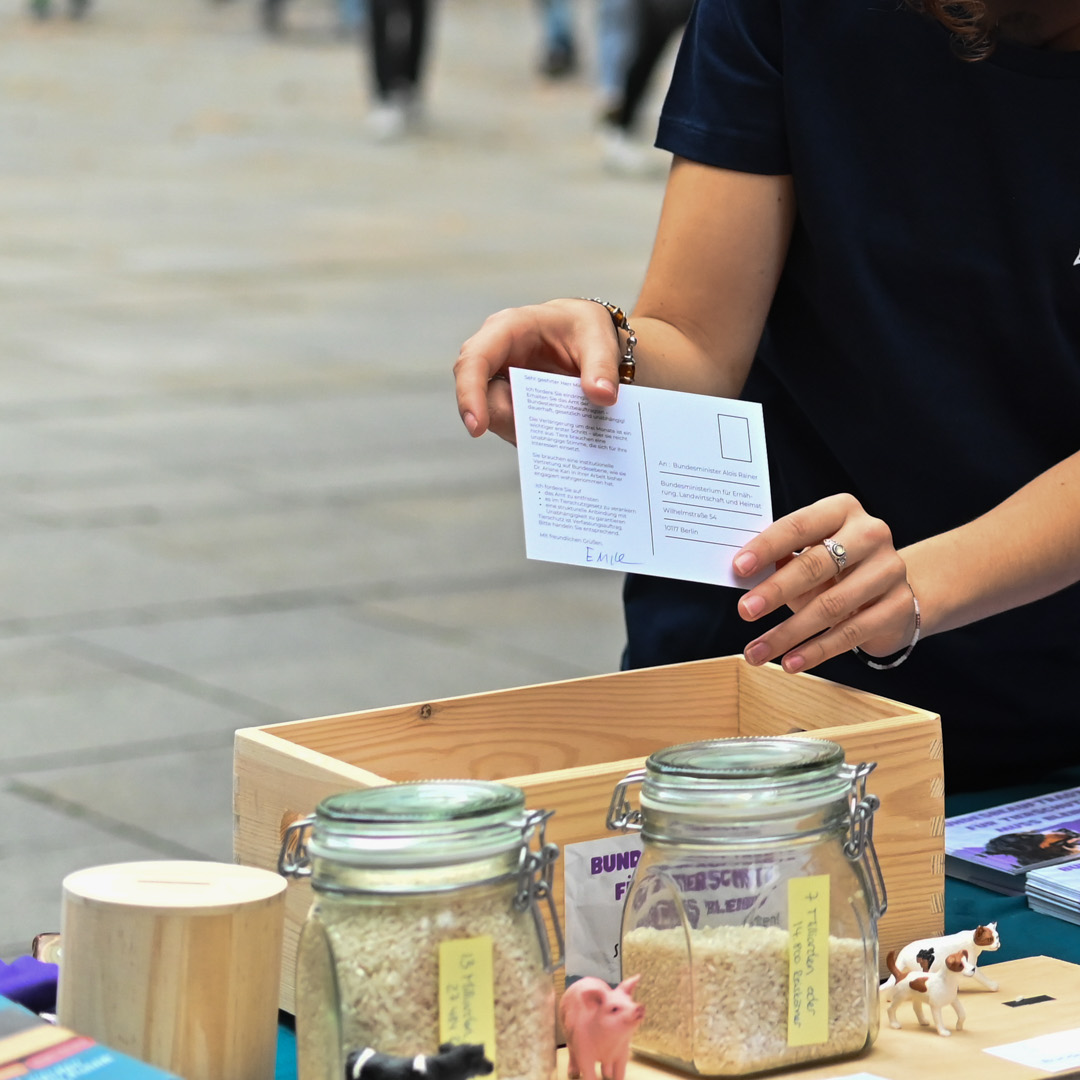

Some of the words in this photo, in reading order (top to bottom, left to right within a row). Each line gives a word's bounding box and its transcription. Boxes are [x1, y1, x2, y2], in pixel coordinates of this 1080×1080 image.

[673, 463, 721, 474] Bundesminister
[661, 481, 721, 494] Bundesministerium
[680, 492, 724, 503] Landwirtschaft
[663, 507, 708, 519] Wilhelmstraße
[591, 850, 642, 875] BUND
[806, 986, 819, 1017] oder
